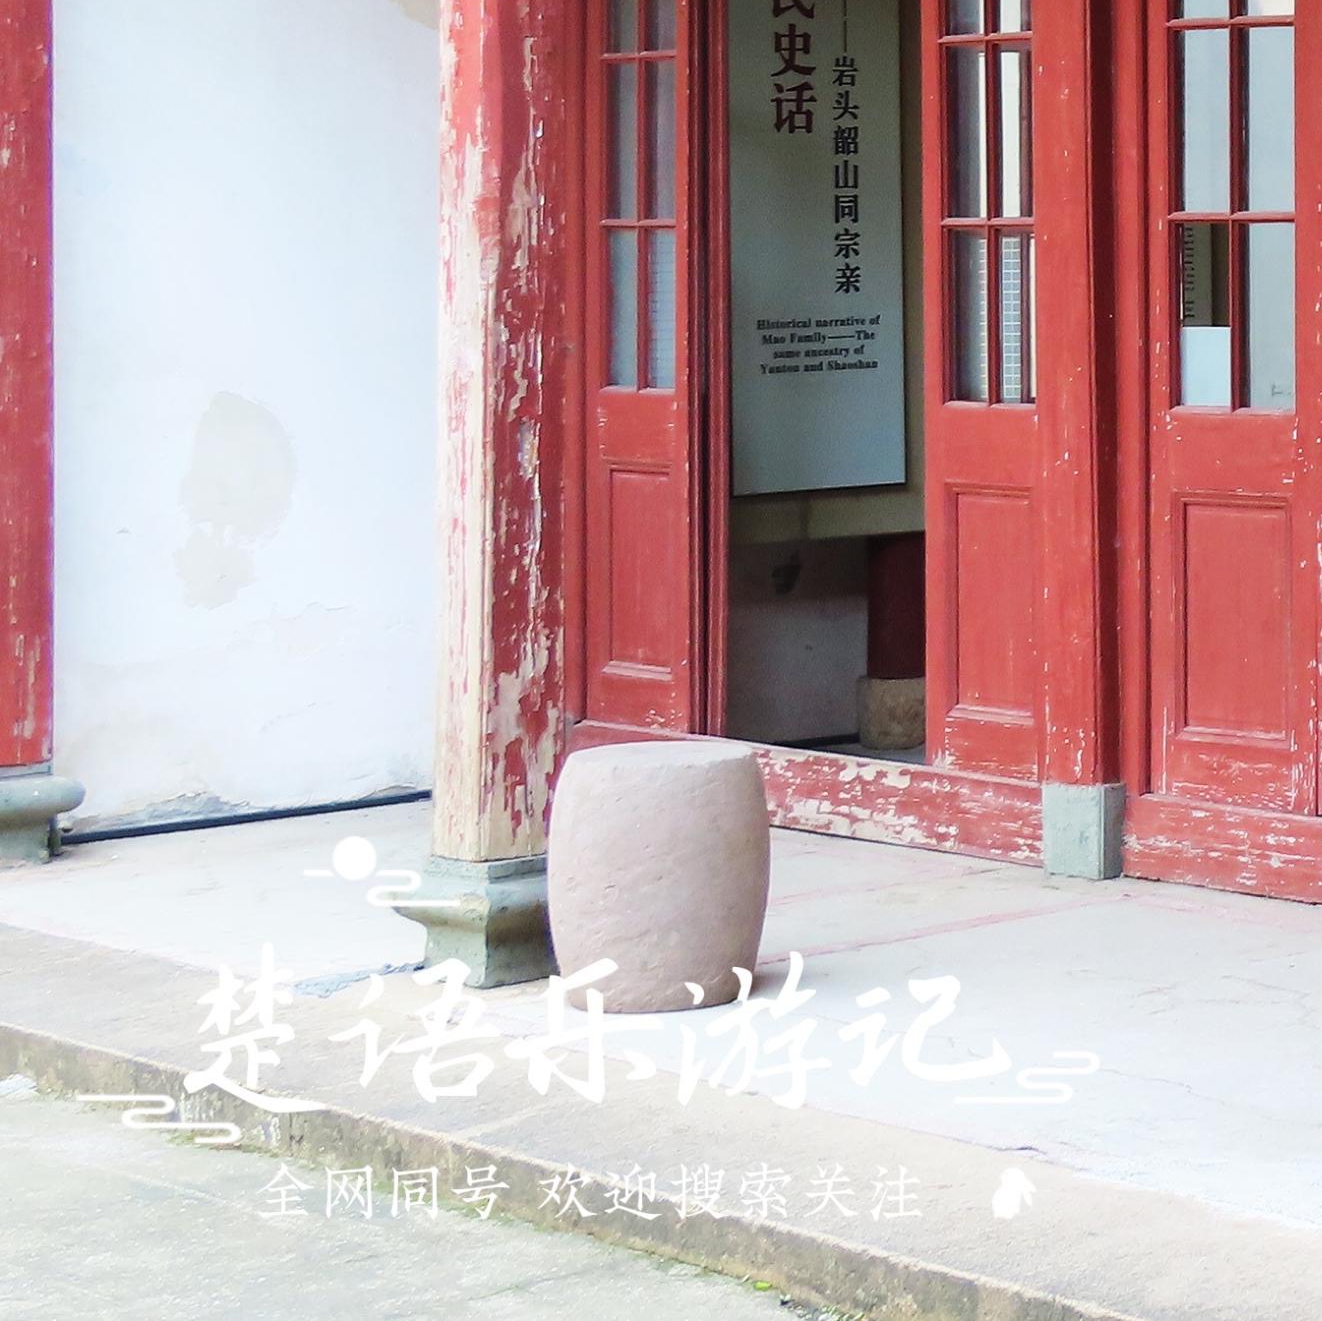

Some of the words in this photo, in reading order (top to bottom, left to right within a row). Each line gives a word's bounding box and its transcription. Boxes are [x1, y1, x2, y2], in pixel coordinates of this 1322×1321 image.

[756, 318, 812, 330] Historical
[815, 316, 866, 328] narrative
[869, 314, 881, 326] of
[762, 334, 786, 345] Mao
[773, 349, 800, 359] same
[804, 347, 850, 358] ancestry
[853, 344, 865, 355] of
[803, 361, 824, 372] and
[827, 359, 878, 371] Shaoshan
